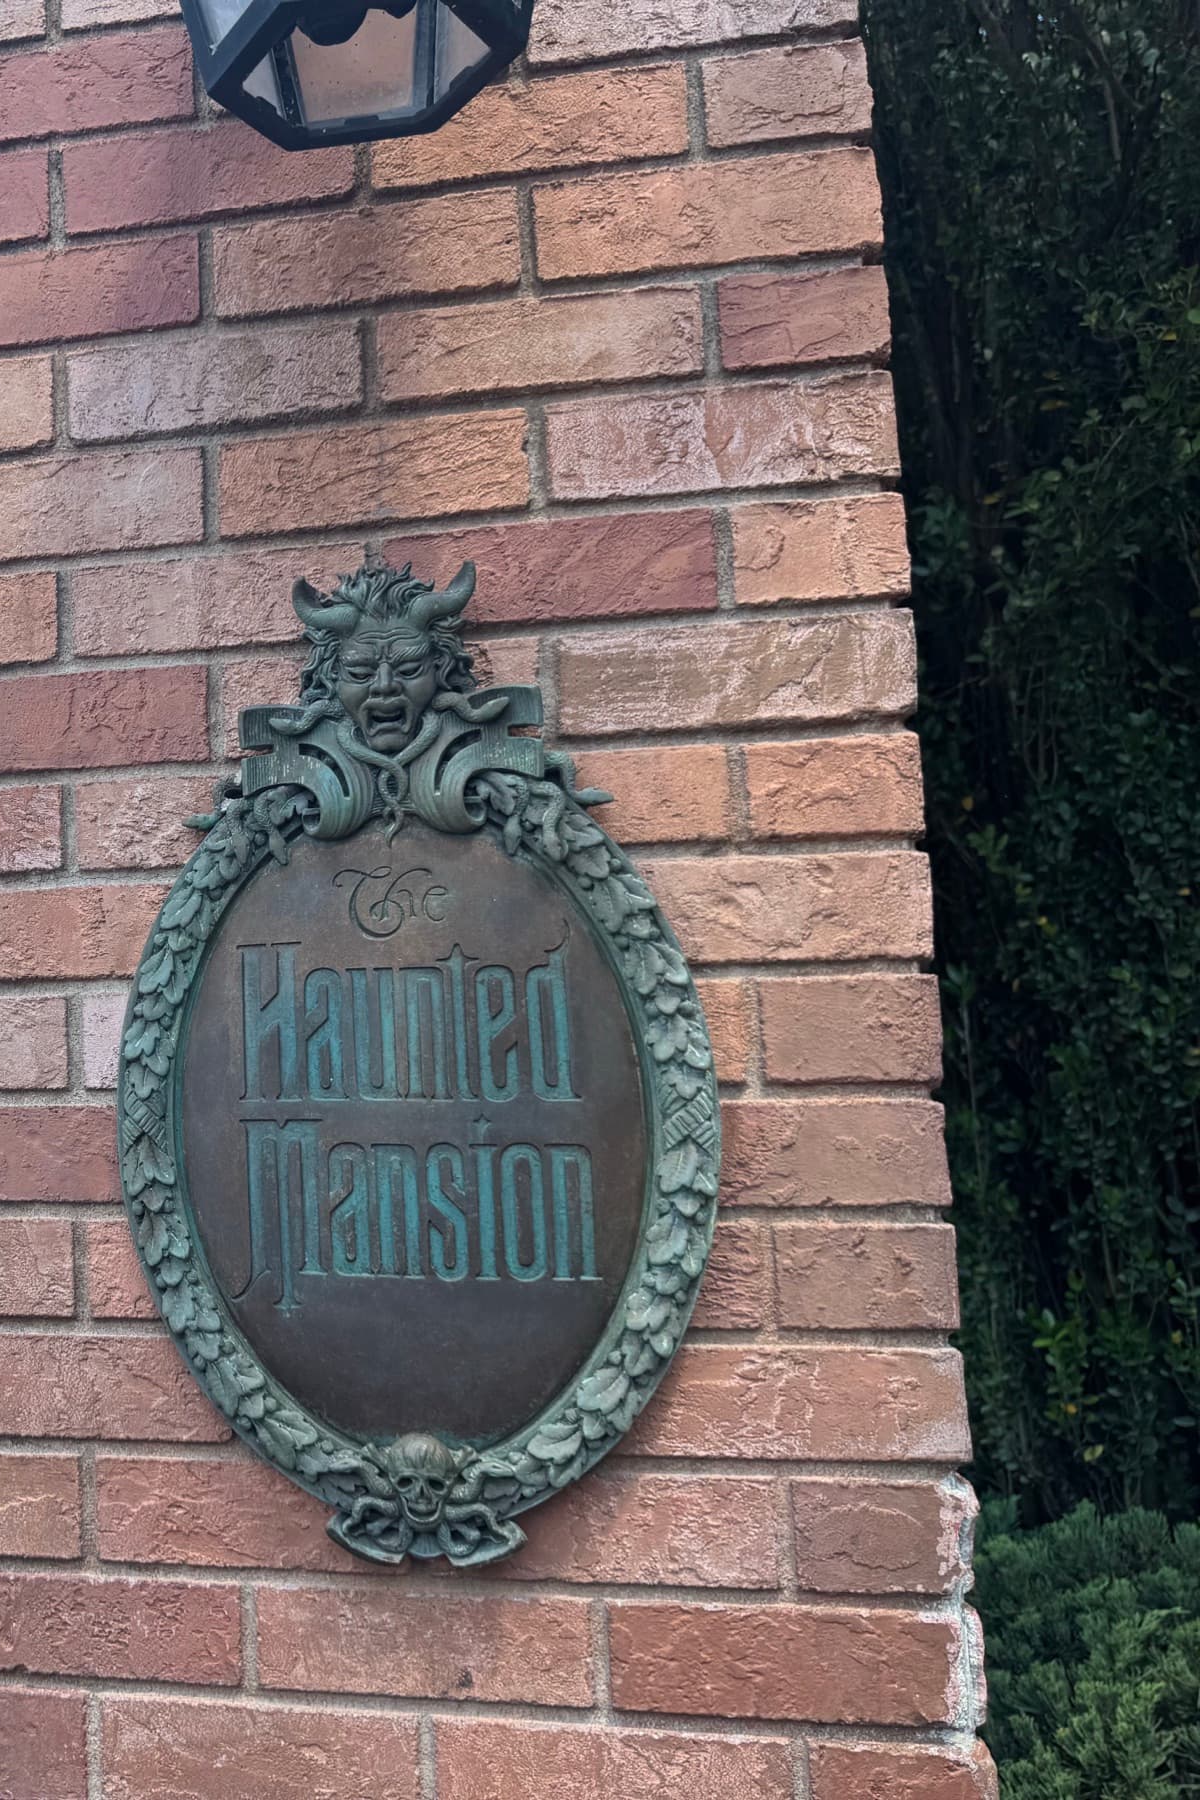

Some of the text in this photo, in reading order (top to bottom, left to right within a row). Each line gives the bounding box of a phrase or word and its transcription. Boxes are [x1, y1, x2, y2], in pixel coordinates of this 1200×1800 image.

[332, 865, 450, 940] The
[236, 918, 583, 1103] Haunted
[231, 1112, 603, 1318] Mansion
